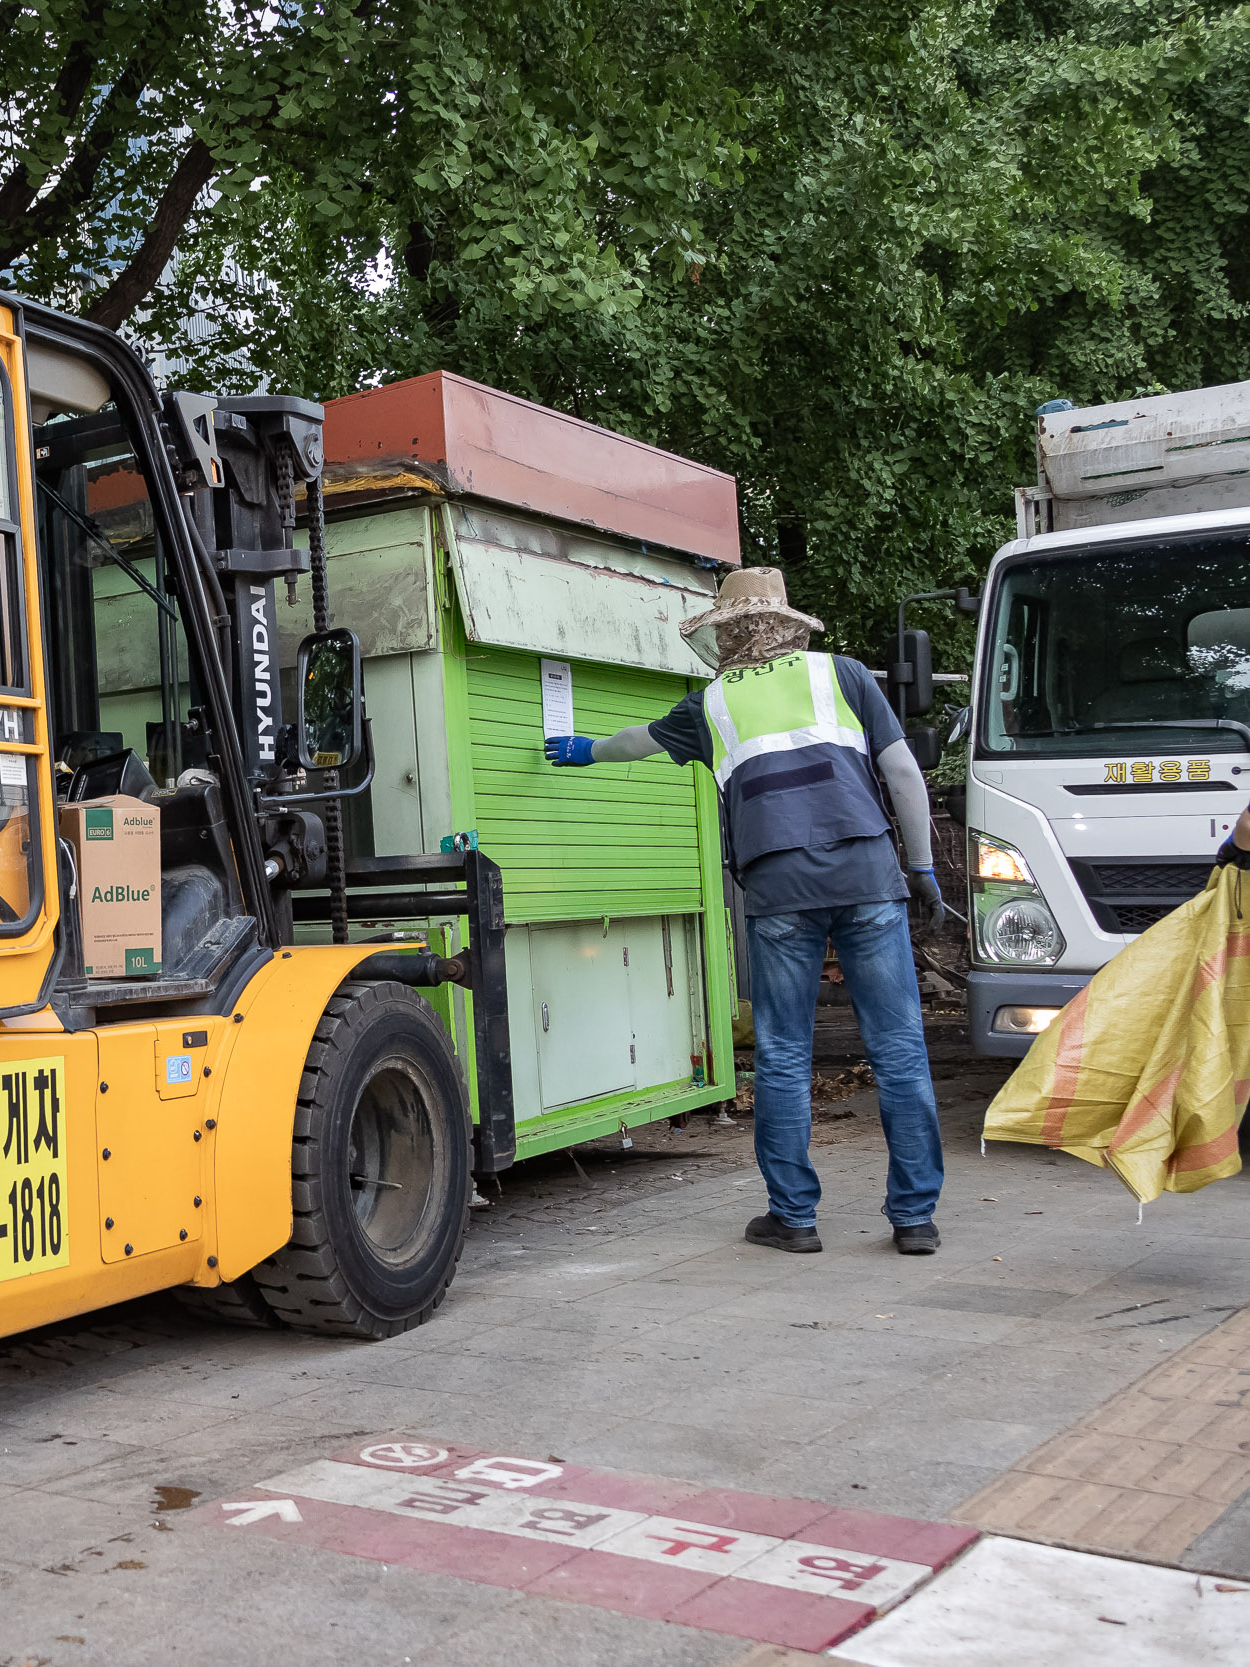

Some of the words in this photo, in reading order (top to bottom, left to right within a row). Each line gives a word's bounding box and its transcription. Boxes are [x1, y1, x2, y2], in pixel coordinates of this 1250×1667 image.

[250, 585, 276, 760] HYUNDAI
[1104, 759, 1212, 783] 재활용품
[123, 816, 153, 826] Adblue
[89, 829, 105, 837] EURO
[131, 956, 148, 968] 10L
[395, 1486, 887, 1591] 금연구역
